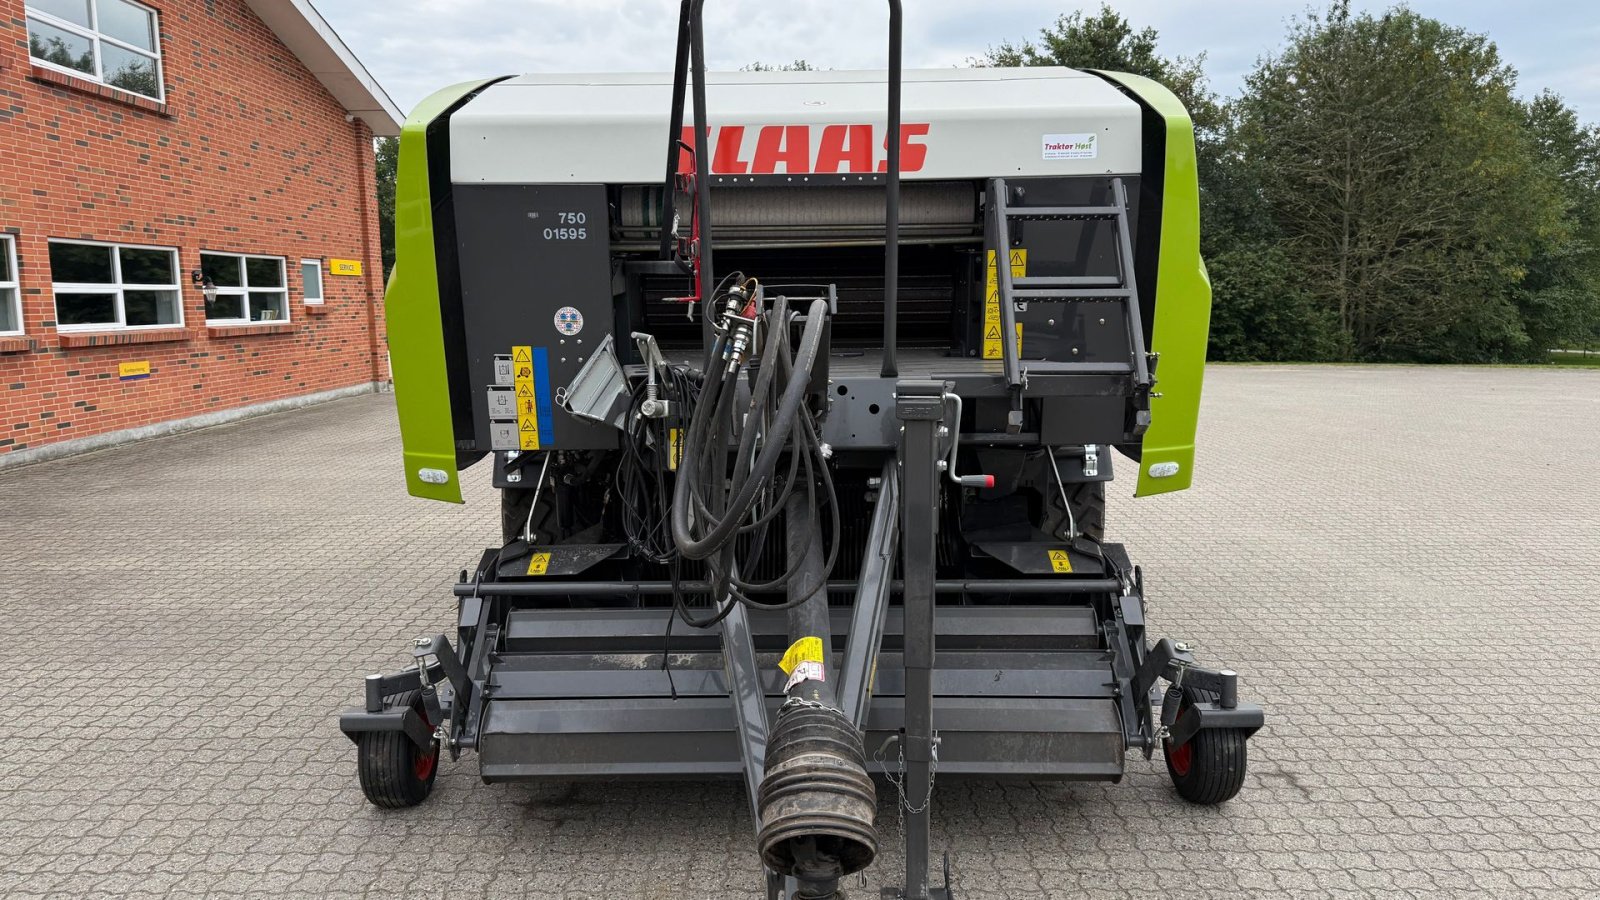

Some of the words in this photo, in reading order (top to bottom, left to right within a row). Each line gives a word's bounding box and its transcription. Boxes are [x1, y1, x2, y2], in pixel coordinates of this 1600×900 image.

[558, 212, 586, 224] 750
[543, 227, 587, 240] 01595
[338, 263, 355, 272] SERVICE
